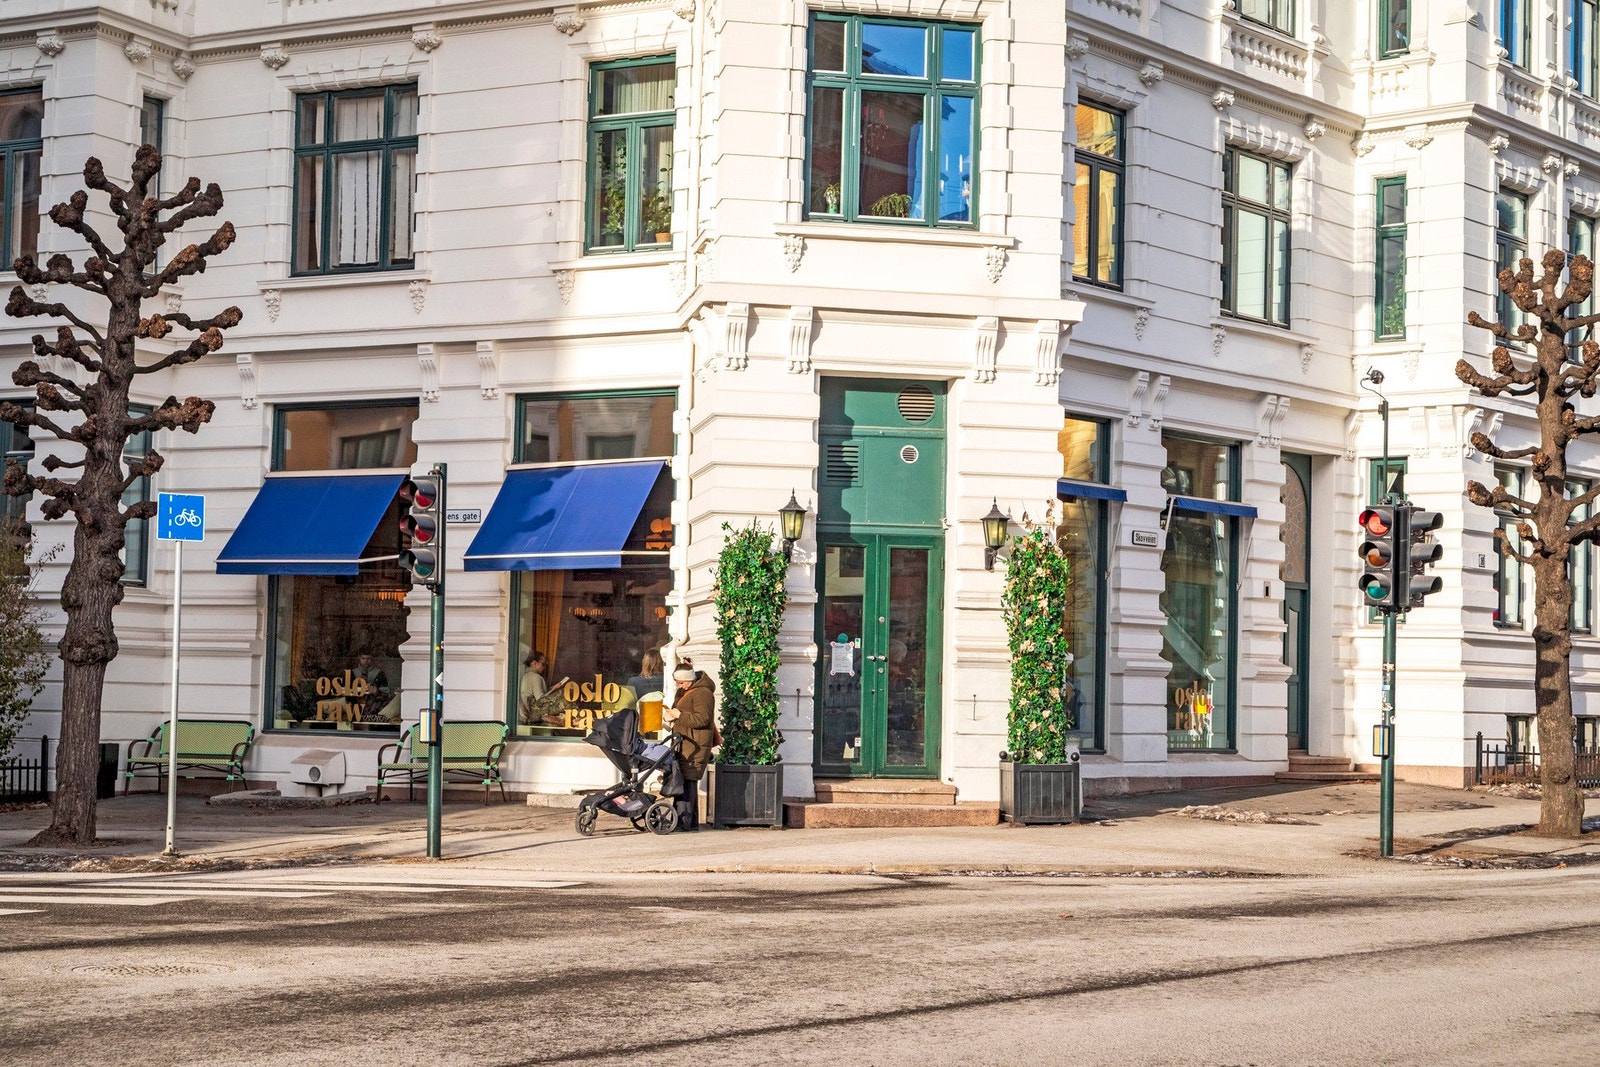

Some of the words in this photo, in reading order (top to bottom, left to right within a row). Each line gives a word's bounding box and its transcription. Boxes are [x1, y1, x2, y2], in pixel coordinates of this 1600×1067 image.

[462, 512, 478, 521] gate
[316, 669, 367, 697] oslo
[563, 673, 621, 703] oslo
[1174, 680, 1208, 706] oslo
[316, 701, 366, 721] raw
